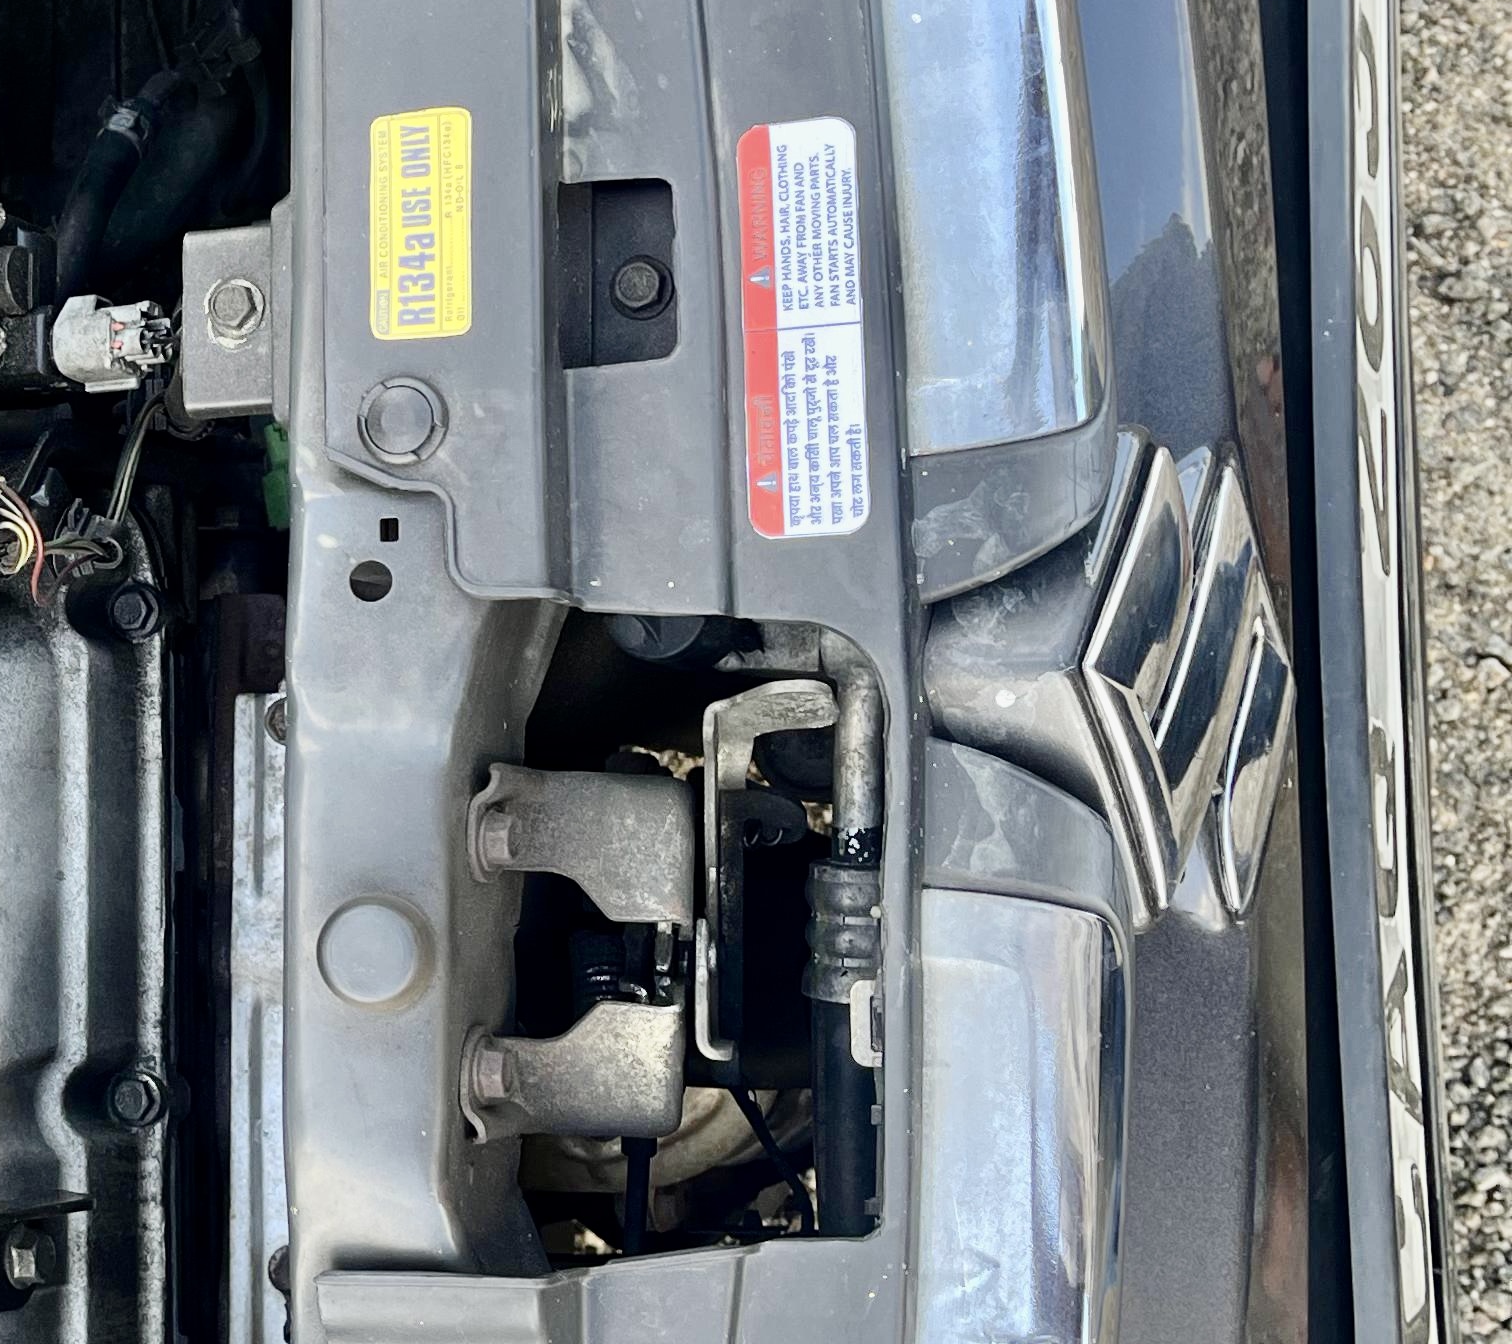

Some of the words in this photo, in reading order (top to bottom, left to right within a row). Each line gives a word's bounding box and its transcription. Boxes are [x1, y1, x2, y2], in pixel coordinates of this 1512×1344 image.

[377, 130, 387, 171] SYSTEM
[399, 124, 430, 178] ONLY
[775, 144, 789, 201] CLOTHING
[793, 161, 804, 187] AND
[823, 142, 839, 236] AUTOMATICALLY
[377, 176, 389, 257] CONDITIONING
[400, 186, 431, 228] USE
[748, 166, 770, 261] WARNING
[794, 188, 805, 212] FAN
[810, 191, 822, 239] MOVING
[795, 214, 807, 248] FROM
[842, 210, 854, 248] CAUSE
[379, 261, 388, 278] AIR
[796, 251, 808, 283] AWAY
[811, 242, 823, 281] OTHER
[827, 239, 839, 281] STARTS
[844, 251, 855, 276] MAY
[396, 232, 436, 326] R134a
[781, 283, 794, 311] KEEP
[797, 285, 809, 309] ETC.
[813, 285, 824, 307] ANY
[829, 284, 840, 306] FAN
[845, 279, 856, 305] AND
[788, 494, 806, 526] कृपया
